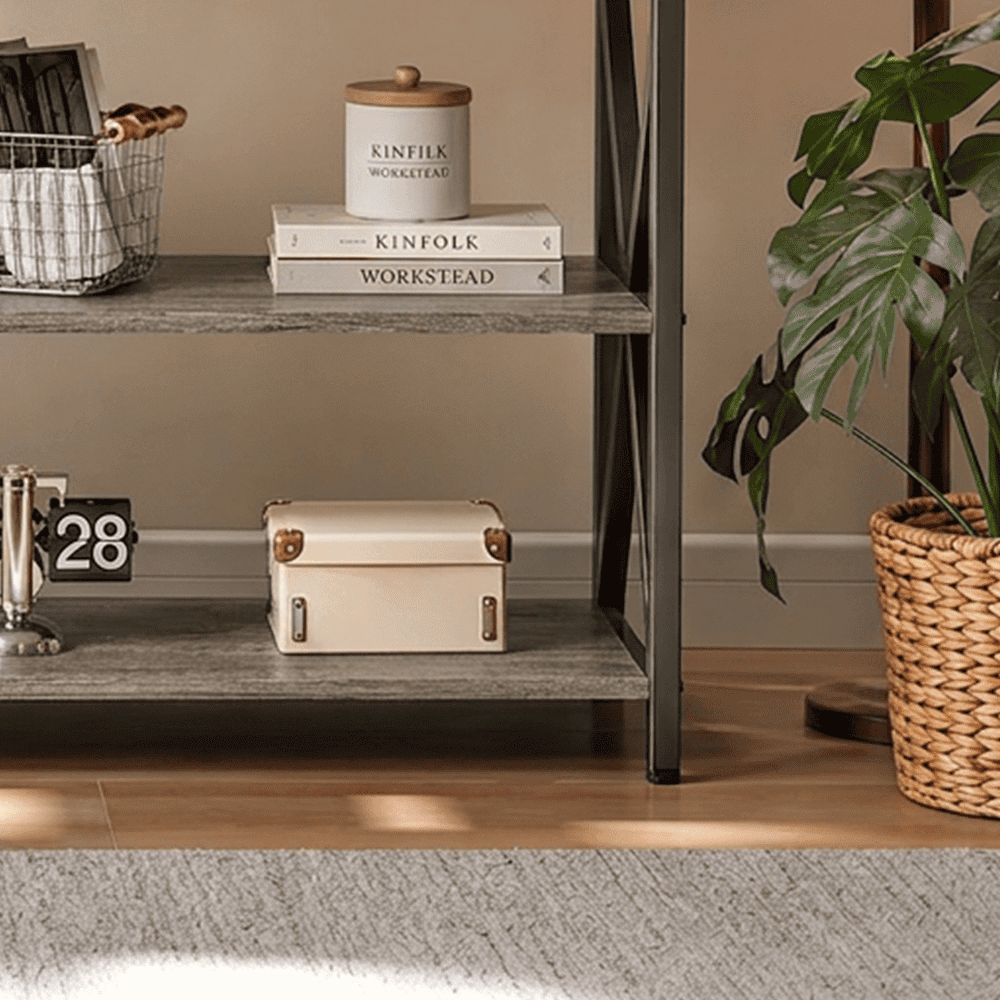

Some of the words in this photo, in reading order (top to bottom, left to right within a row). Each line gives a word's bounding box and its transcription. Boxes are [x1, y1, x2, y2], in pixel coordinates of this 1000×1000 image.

[375, 234, 479, 249] KINFOLK
[360, 268, 495, 285] WORKSTEAD
[56, 514, 129, 571] 28
